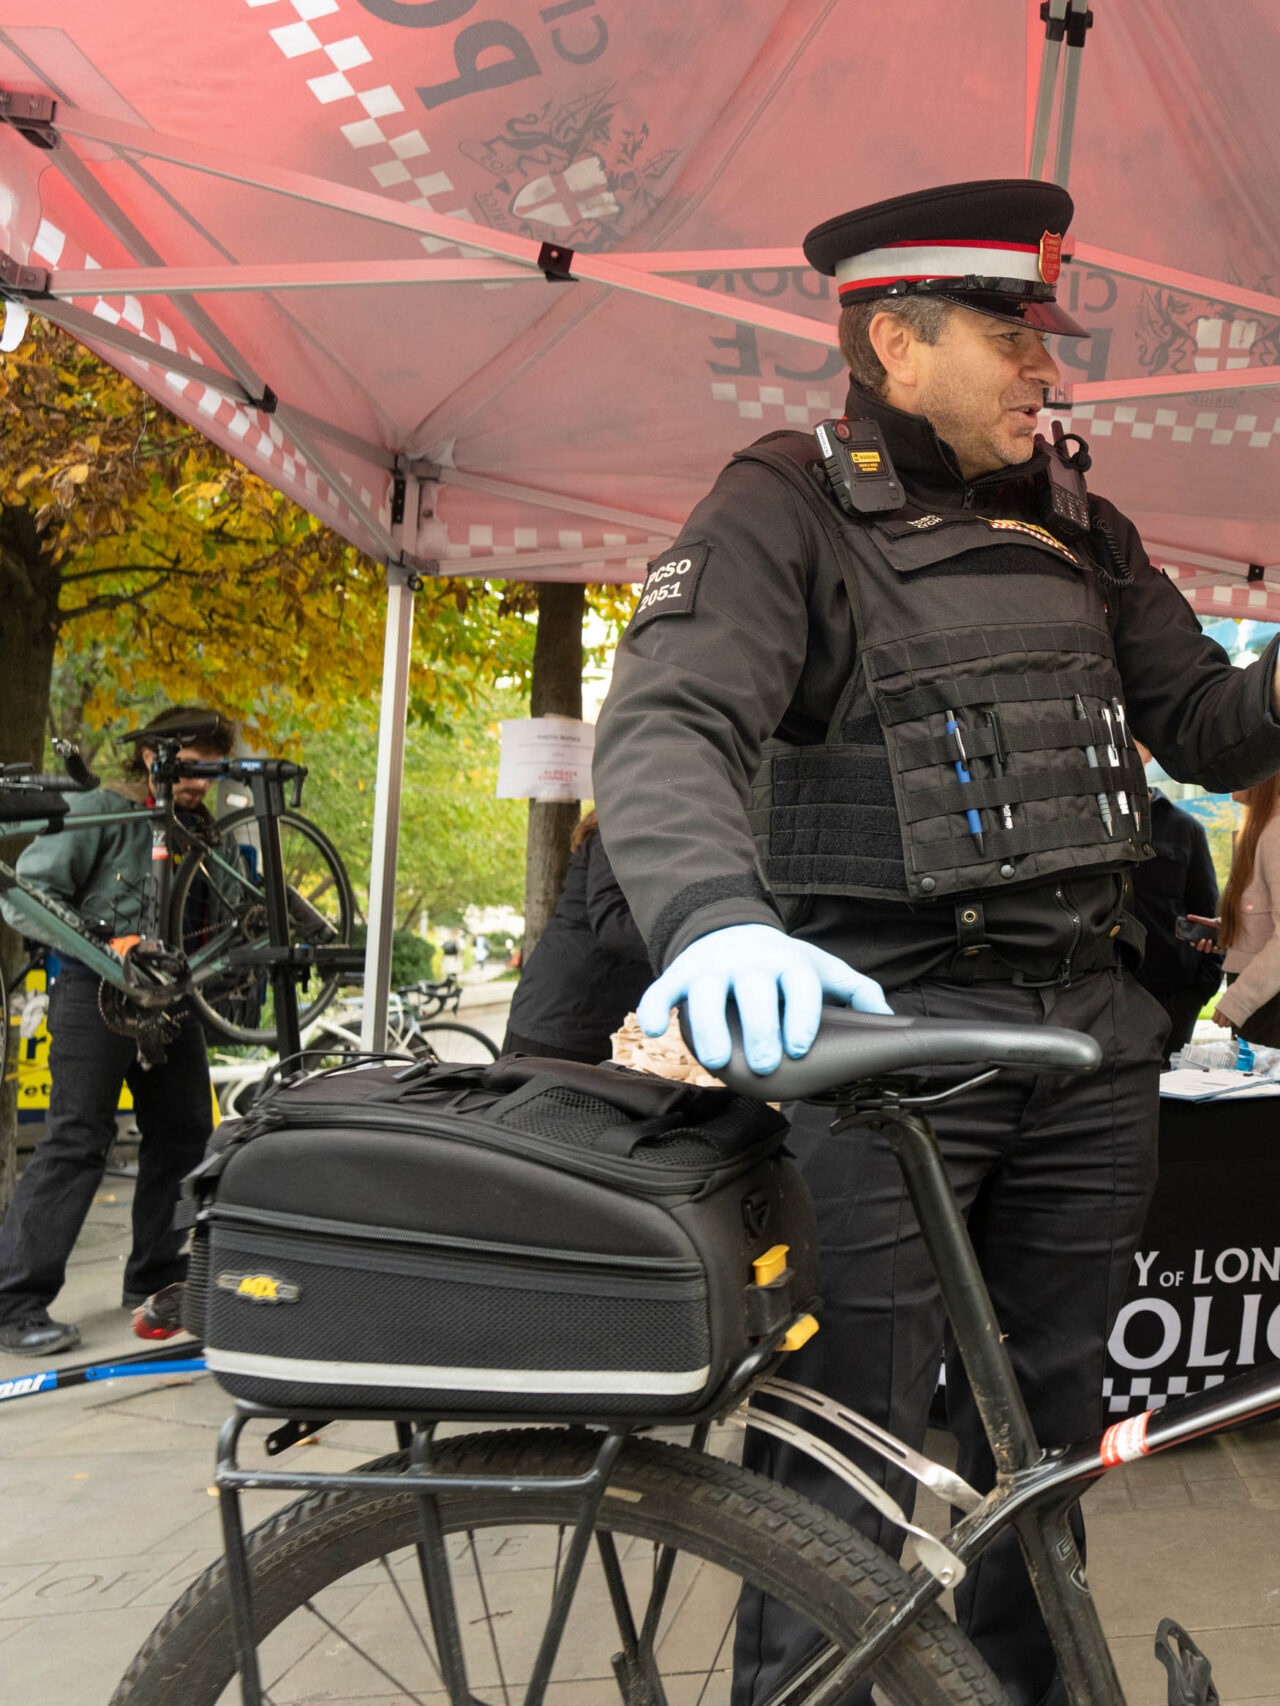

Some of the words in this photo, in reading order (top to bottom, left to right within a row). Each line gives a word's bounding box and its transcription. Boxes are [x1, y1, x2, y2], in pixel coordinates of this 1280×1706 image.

[645, 558, 692, 591] PCSO
[637, 581, 683, 614] 2051
[1159, 1271, 1185, 1287] OF
